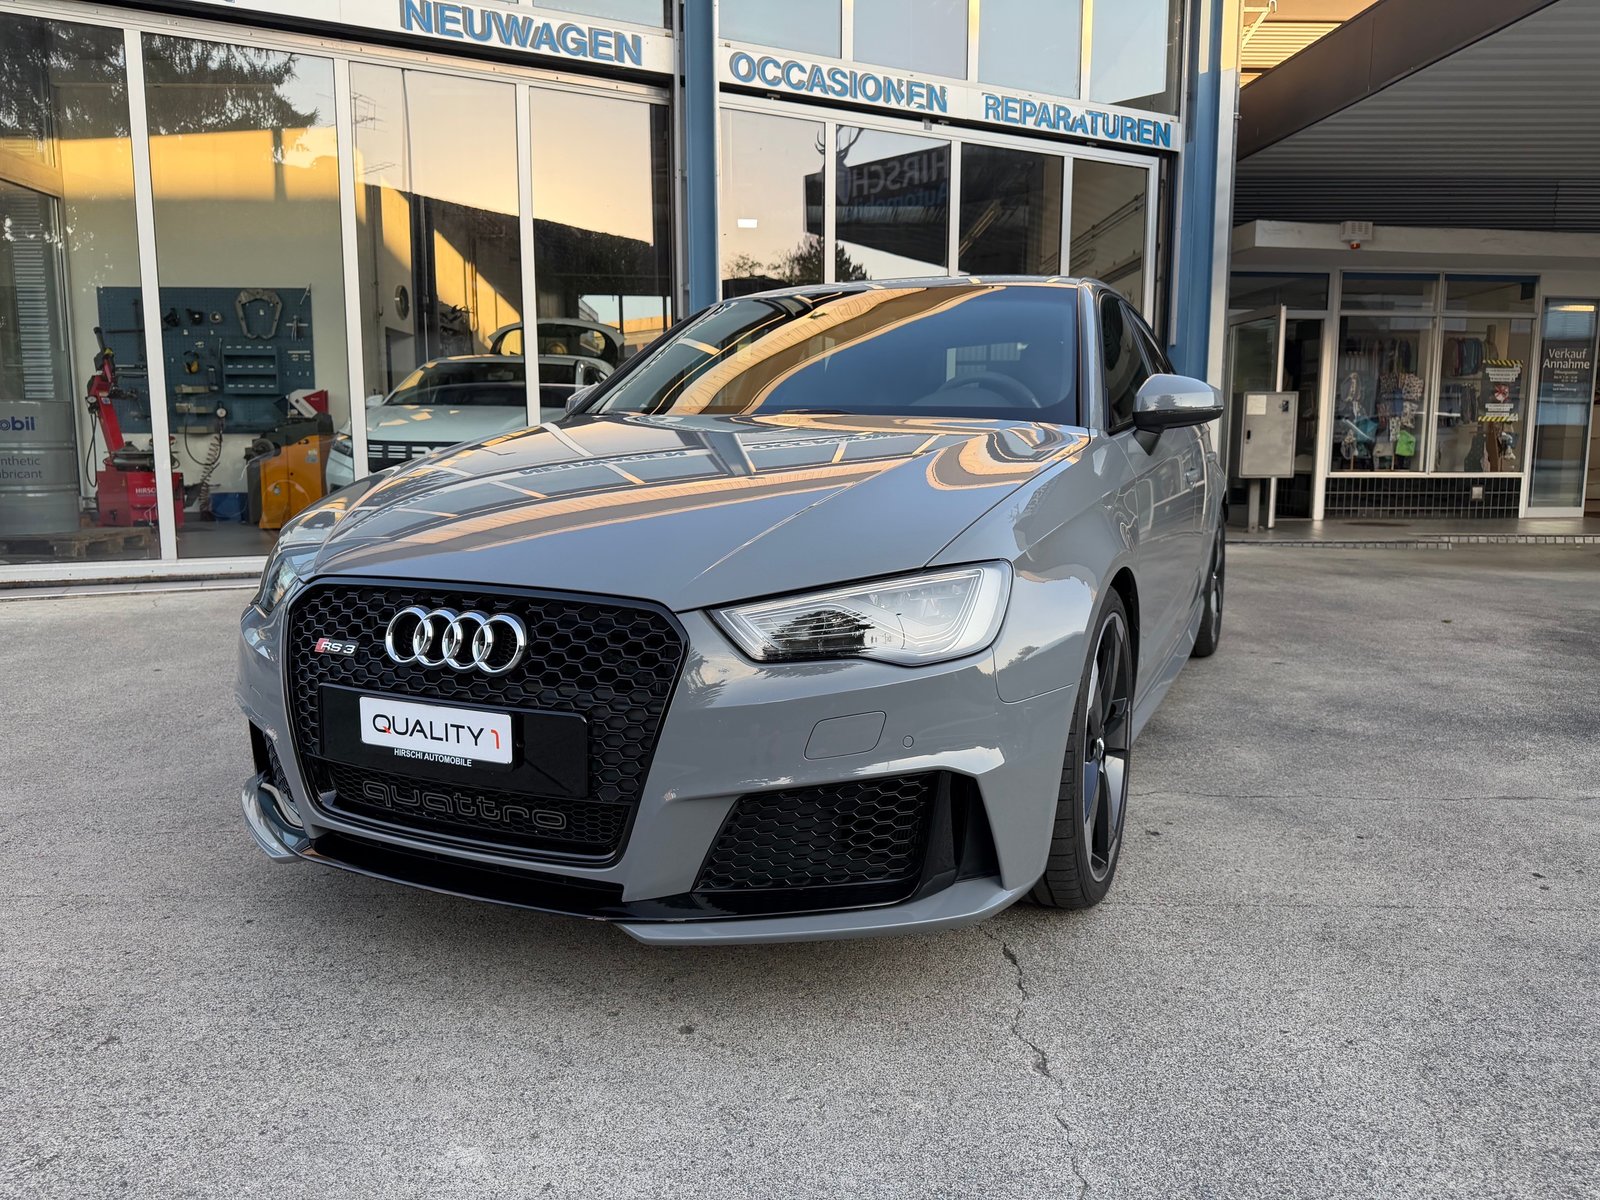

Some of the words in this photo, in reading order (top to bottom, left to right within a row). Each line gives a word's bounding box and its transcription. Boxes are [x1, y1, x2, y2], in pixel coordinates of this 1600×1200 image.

[400, 0, 642, 66] NEUWAGEN
[729, 51, 948, 113] OCCASIONEN
[982, 92, 1172, 148] REPARATUREN
[1542, 359, 1590, 369] Annahme
[1548, 348, 1587, 359] Verkauf
[320, 641, 343, 652] RS
[343, 644, 356, 654] 3
[372, 713, 485, 747] QUALITY
[490, 728, 500, 750] 1
[393, 748, 423, 760] HIRSCHI
[423, 753, 472, 767] AUTOMOBILE
[362, 780, 567, 830] quattro
